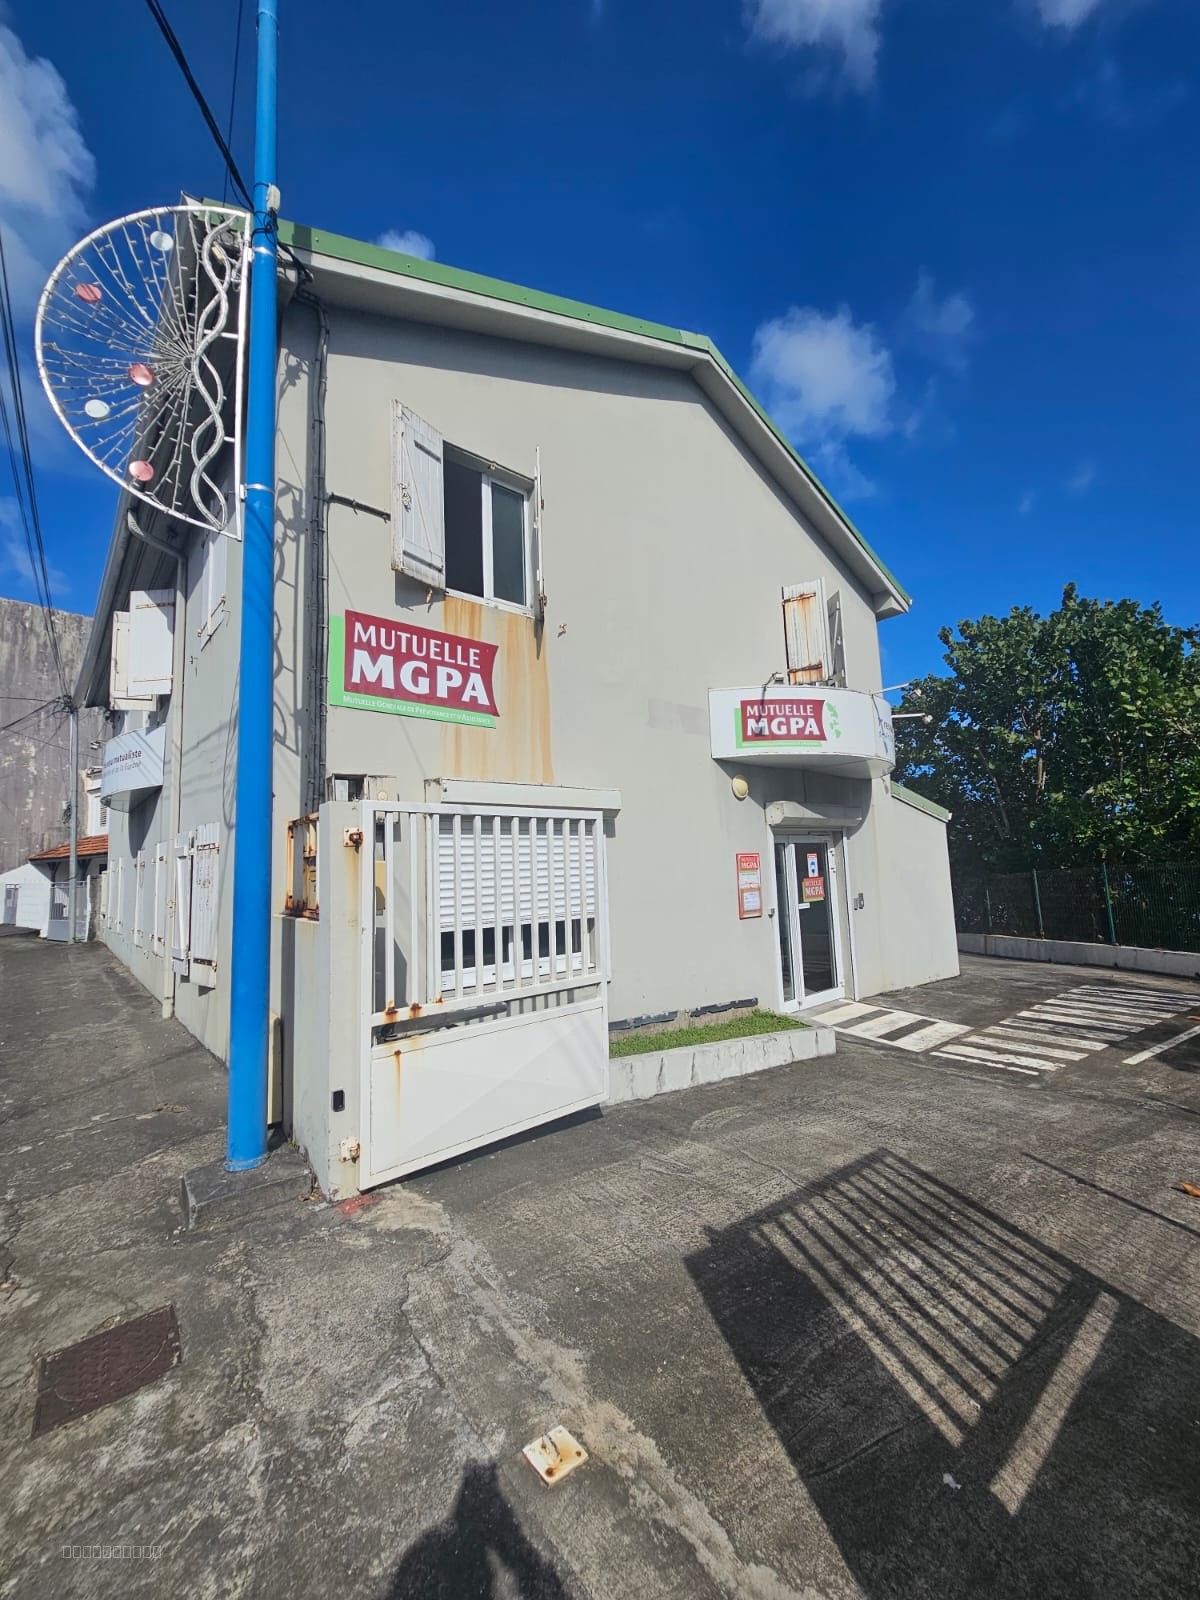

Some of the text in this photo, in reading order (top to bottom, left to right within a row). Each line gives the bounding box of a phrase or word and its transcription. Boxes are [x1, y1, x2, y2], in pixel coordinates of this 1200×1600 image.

[353, 622, 481, 669] MUTUELLE
[351, 649, 491, 706] MGPA
[746, 704, 815, 717] MUTUELLE
[747, 717, 820, 737] MGPA
[805, 886, 824, 896] MGPA
